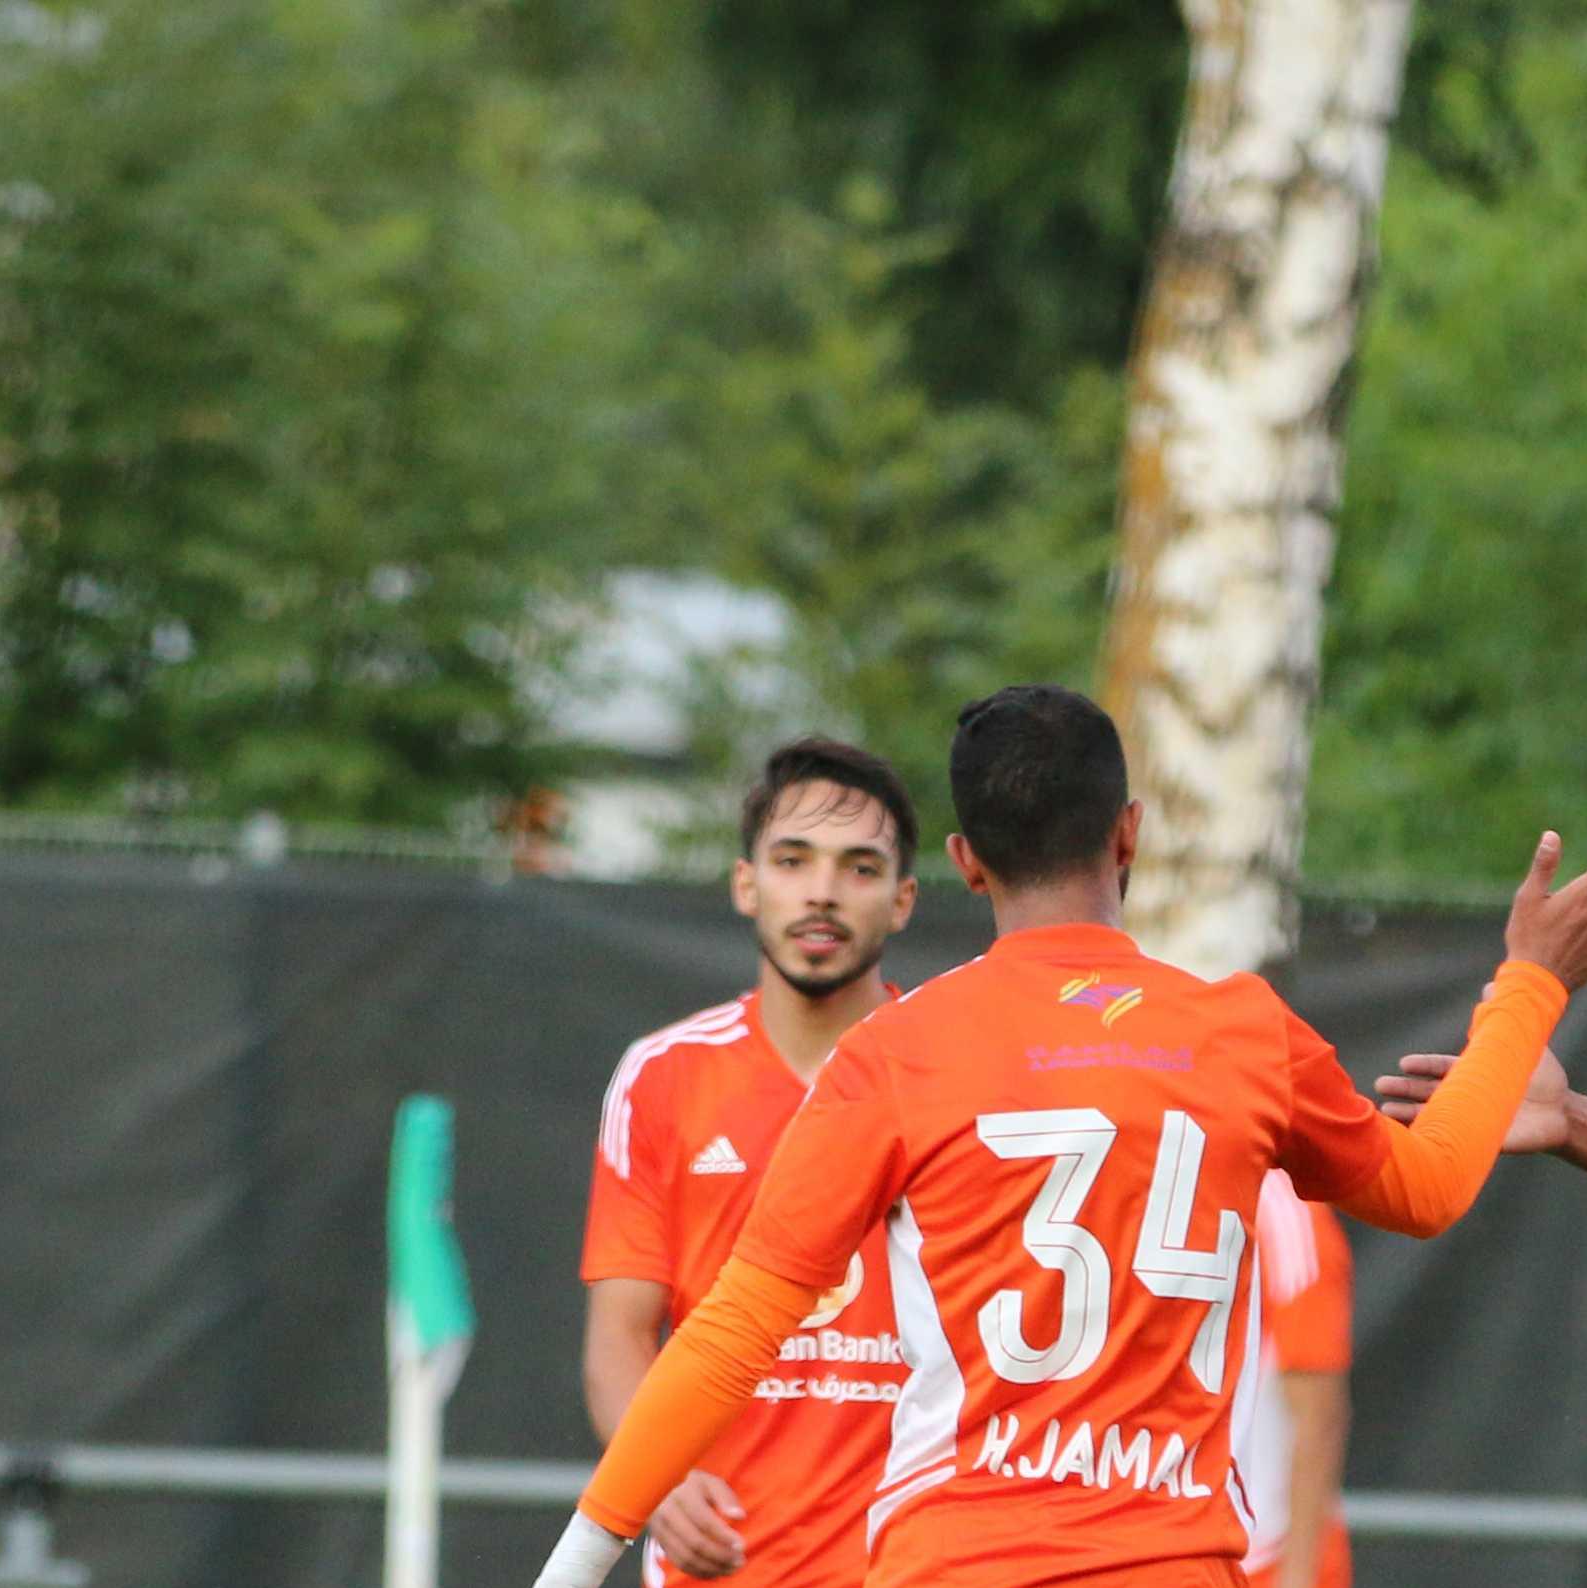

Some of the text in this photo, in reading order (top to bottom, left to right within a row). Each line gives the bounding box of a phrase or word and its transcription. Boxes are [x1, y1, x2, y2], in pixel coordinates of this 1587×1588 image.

[977, 1107, 1246, 1395] 34
[819, 1330, 903, 1364] Bank
[972, 1413, 1212, 1498] H.JAMAL
